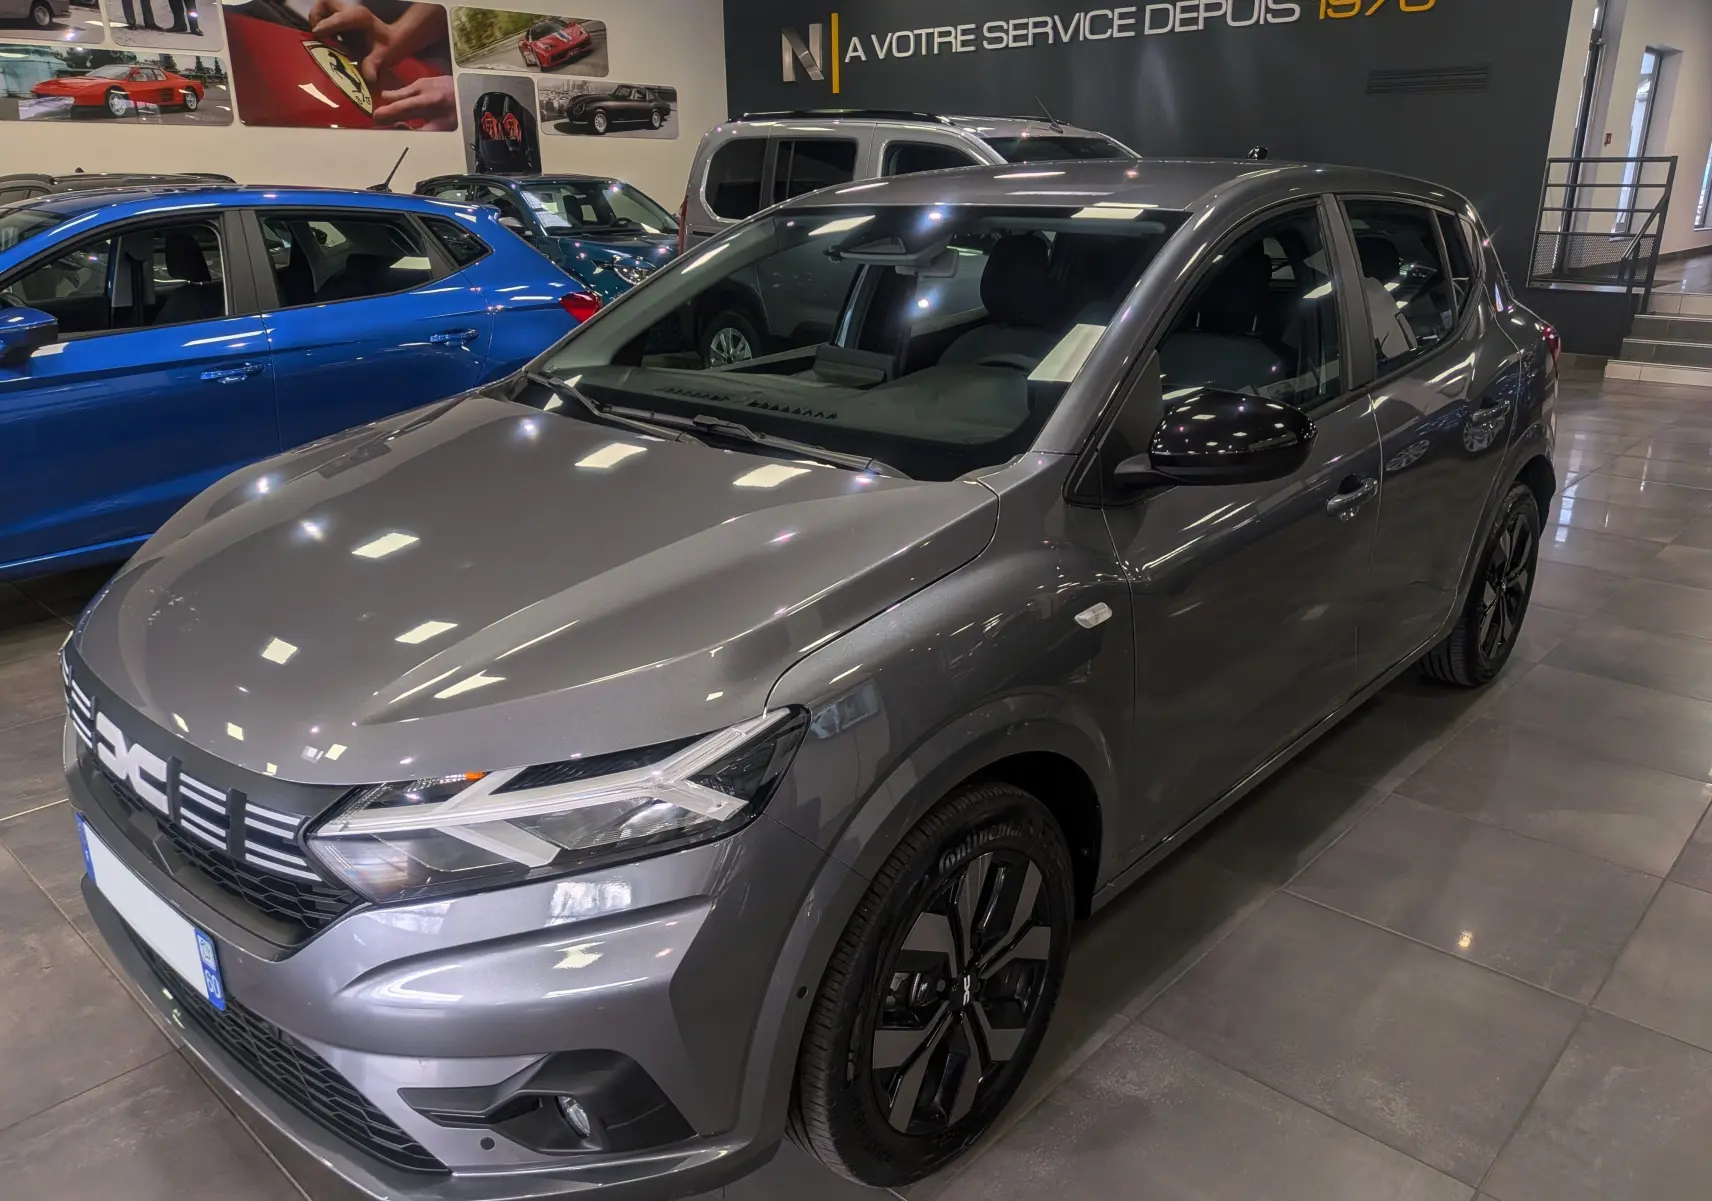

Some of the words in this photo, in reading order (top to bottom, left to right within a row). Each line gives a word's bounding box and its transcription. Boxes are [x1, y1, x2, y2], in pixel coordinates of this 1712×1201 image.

[844, 36, 867, 63] A
[871, 23, 976, 60] VOTRE
[982, 6, 1137, 50] SERVICE
[1144, 0, 1300, 35] DEPUIS
[204, 969, 222, 999] 60
